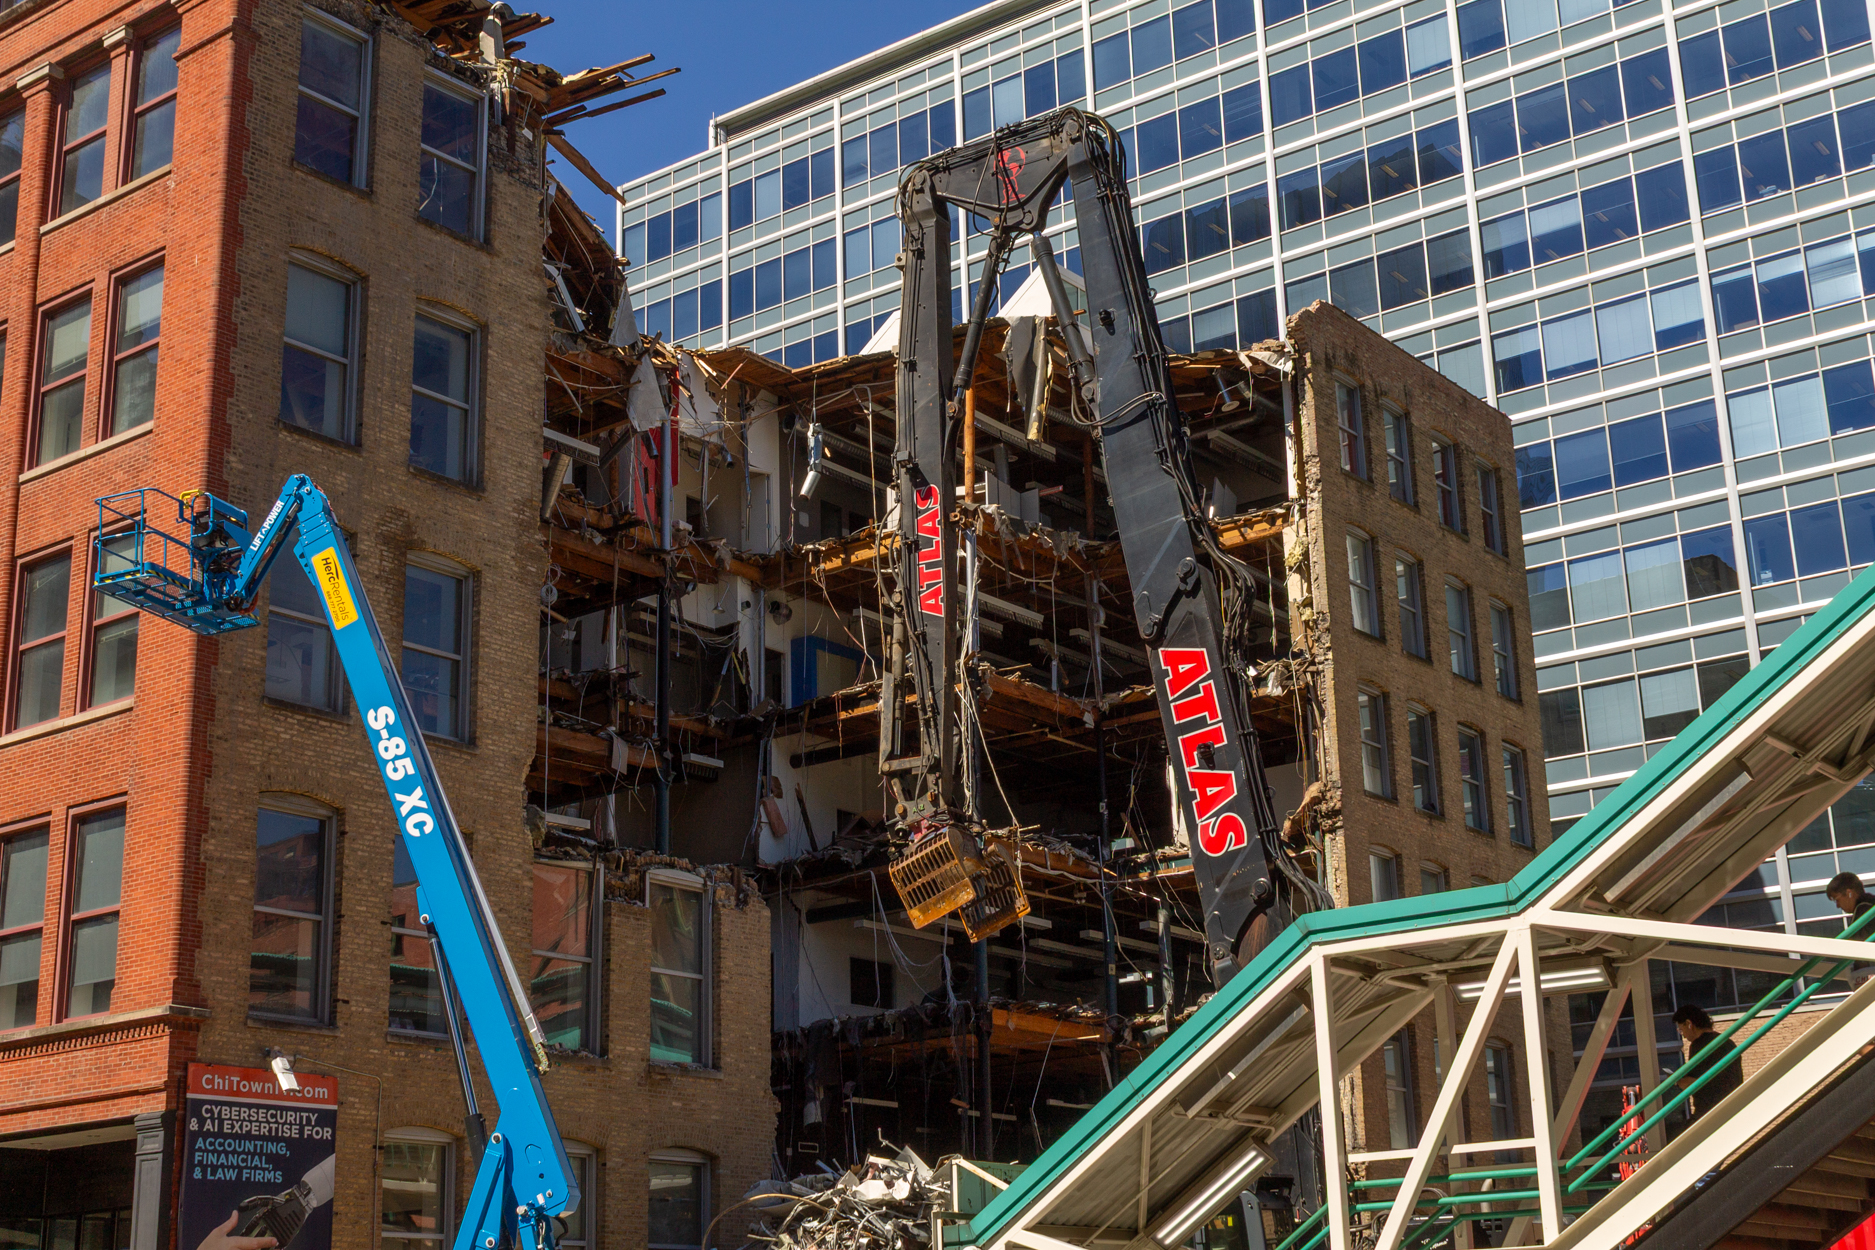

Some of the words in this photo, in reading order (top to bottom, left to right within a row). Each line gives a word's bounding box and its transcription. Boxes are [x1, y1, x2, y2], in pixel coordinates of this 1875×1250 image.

[914, 484, 944, 617] ATLAS
[1158, 648, 1247, 857] ATLAS
[367, 706, 415, 781] S-85
[394, 786, 434, 837] XC
[202, 1074, 328, 1099] ChiTownI.com
[202, 1105, 318, 1125] CYBERSECURITY
[190, 1118, 199, 1131] &
[203, 1119, 218, 1132] AI
[223, 1121, 300, 1138] EXPERTISE
[304, 1127, 332, 1140] FOR
[195, 1137, 290, 1157] ACCOUNTING,
[195, 1152, 273, 1170] FINANCIAL,
[193, 1167, 202, 1179] &
[207, 1168, 238, 1181] LAW
[242, 1171, 283, 1183] FIRMS
